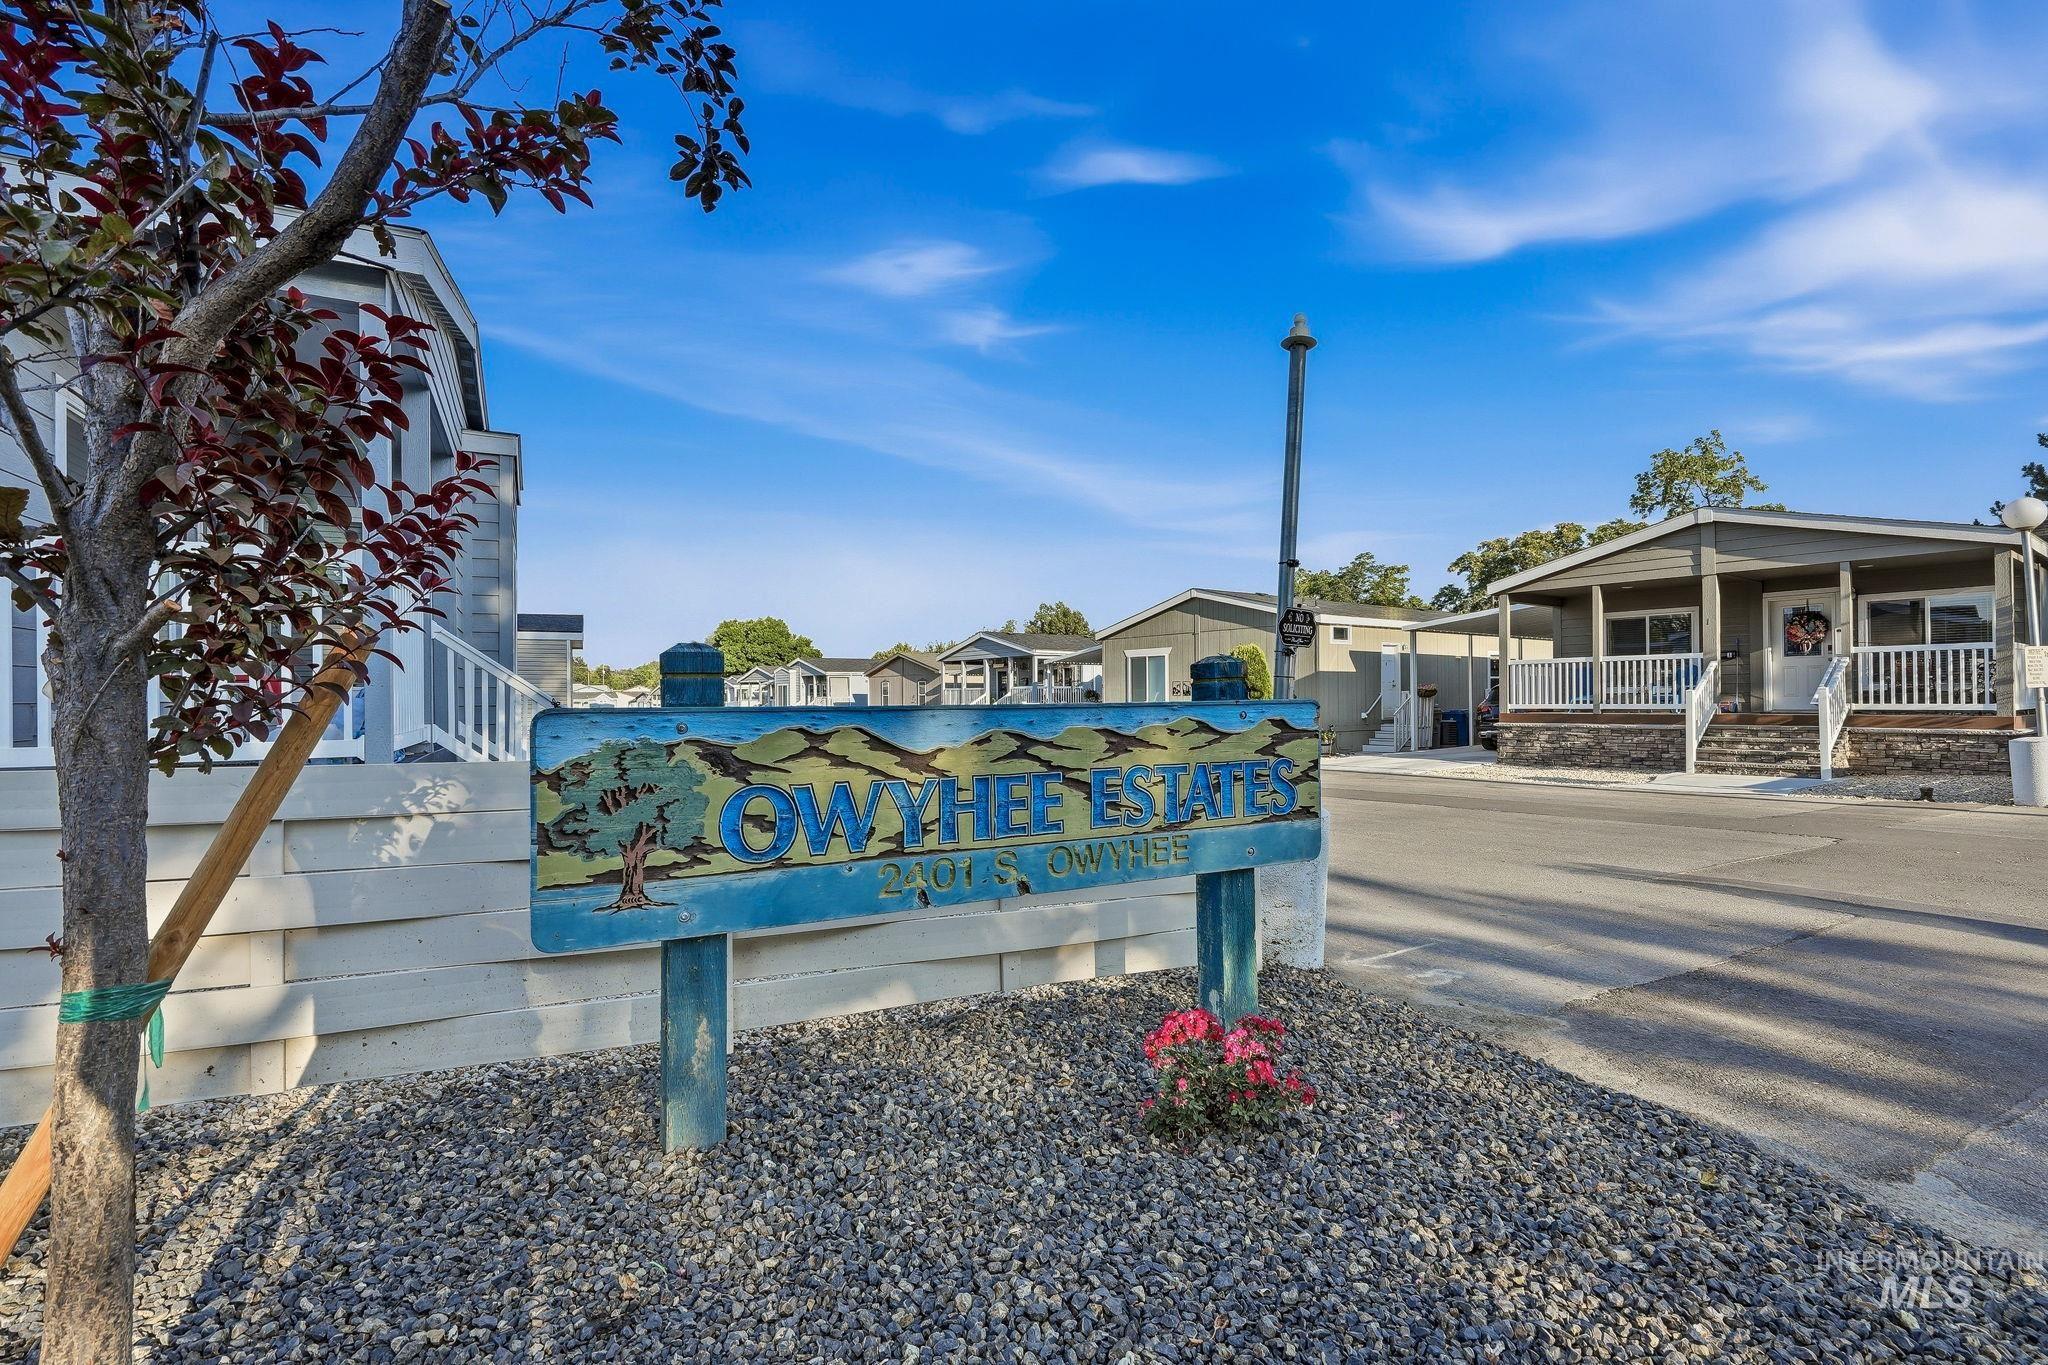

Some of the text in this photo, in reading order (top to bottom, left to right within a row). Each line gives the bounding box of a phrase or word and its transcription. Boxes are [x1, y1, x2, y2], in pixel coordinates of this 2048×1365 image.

[1283, 623, 1313, 635] SOLICITING
[1295, 612, 1304, 622] NO
[719, 757, 1298, 864] OWYHEE ESTATES
[878, 856, 973, 898] 2401
[1047, 834, 1190, 877] OWYHEE
